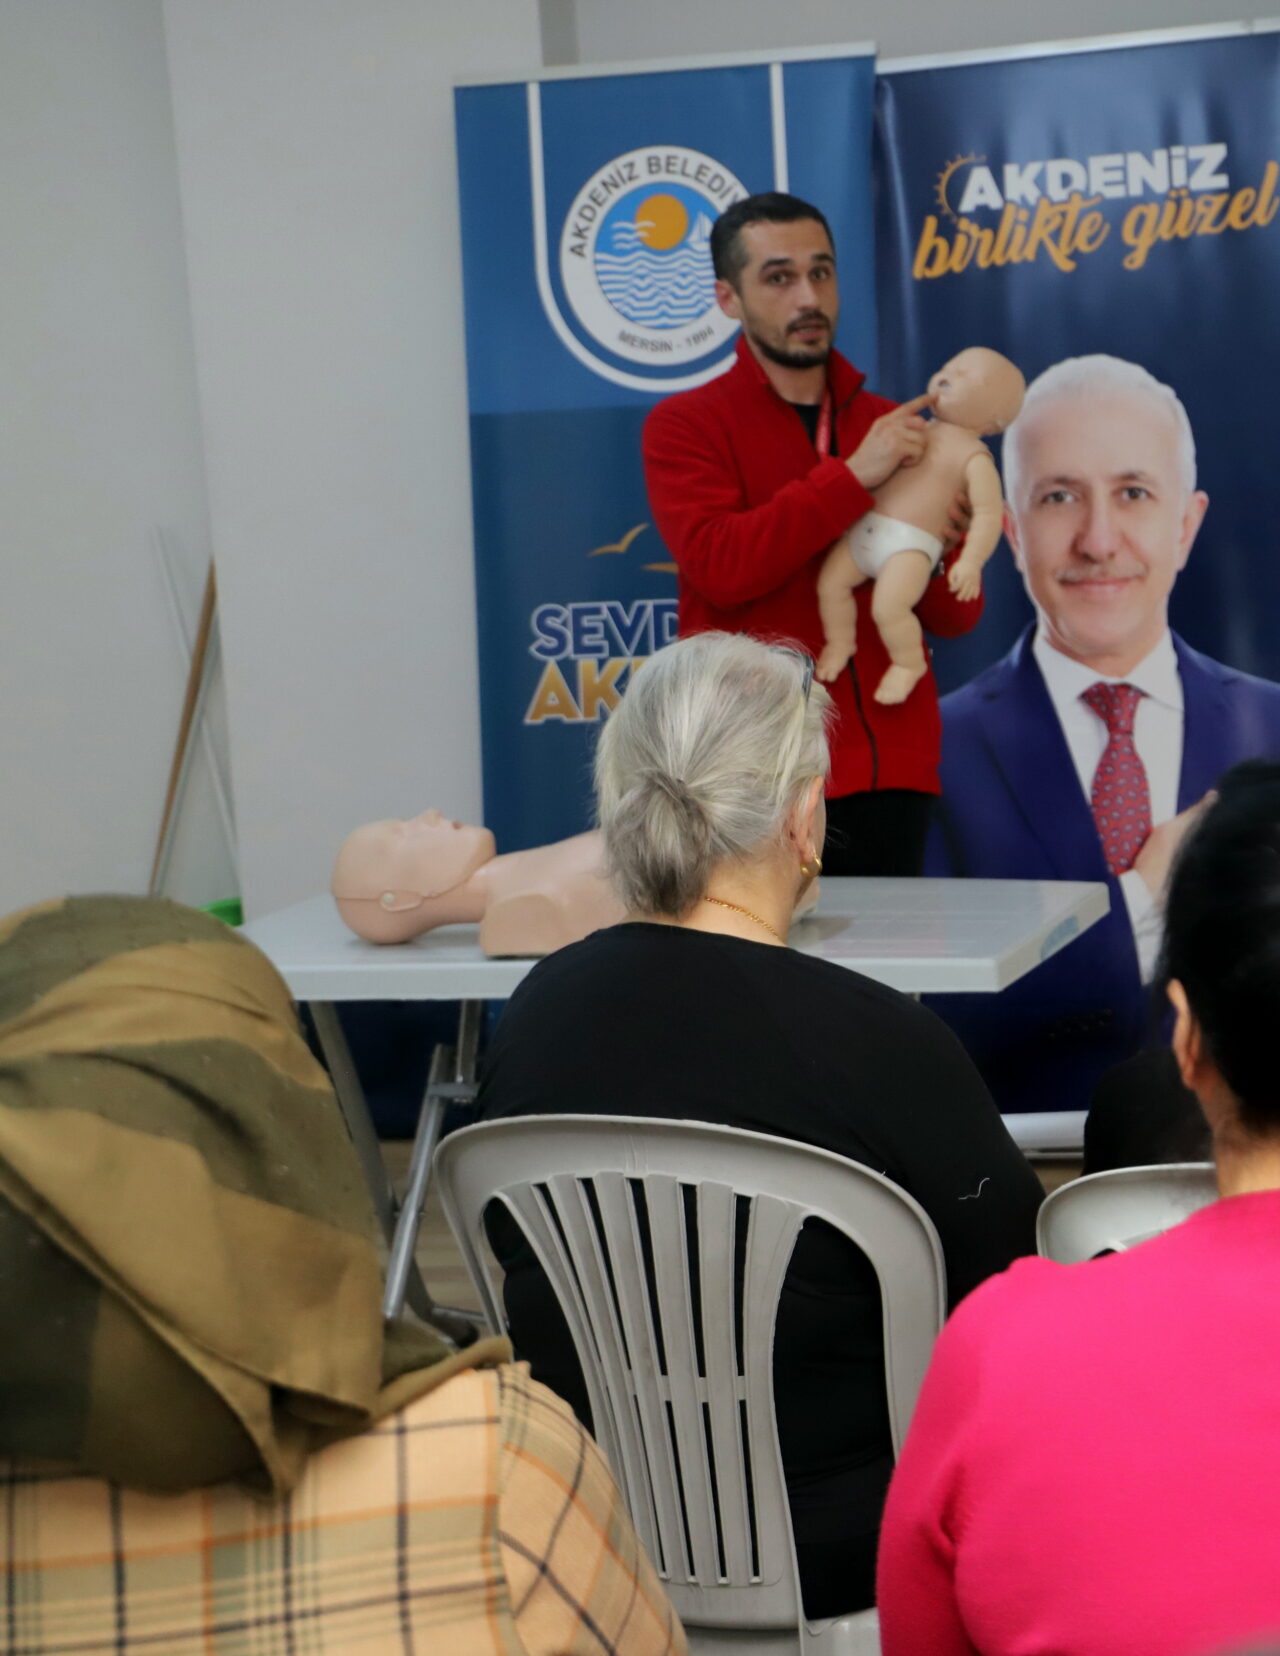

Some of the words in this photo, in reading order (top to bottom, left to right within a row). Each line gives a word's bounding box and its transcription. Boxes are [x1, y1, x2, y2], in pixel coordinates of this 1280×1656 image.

[569, 161, 640, 259] AKDENİZ
[912, 192, 1110, 280] birlikte
[1121, 160, 1280, 271] güzel
[523, 655, 651, 725] AK
